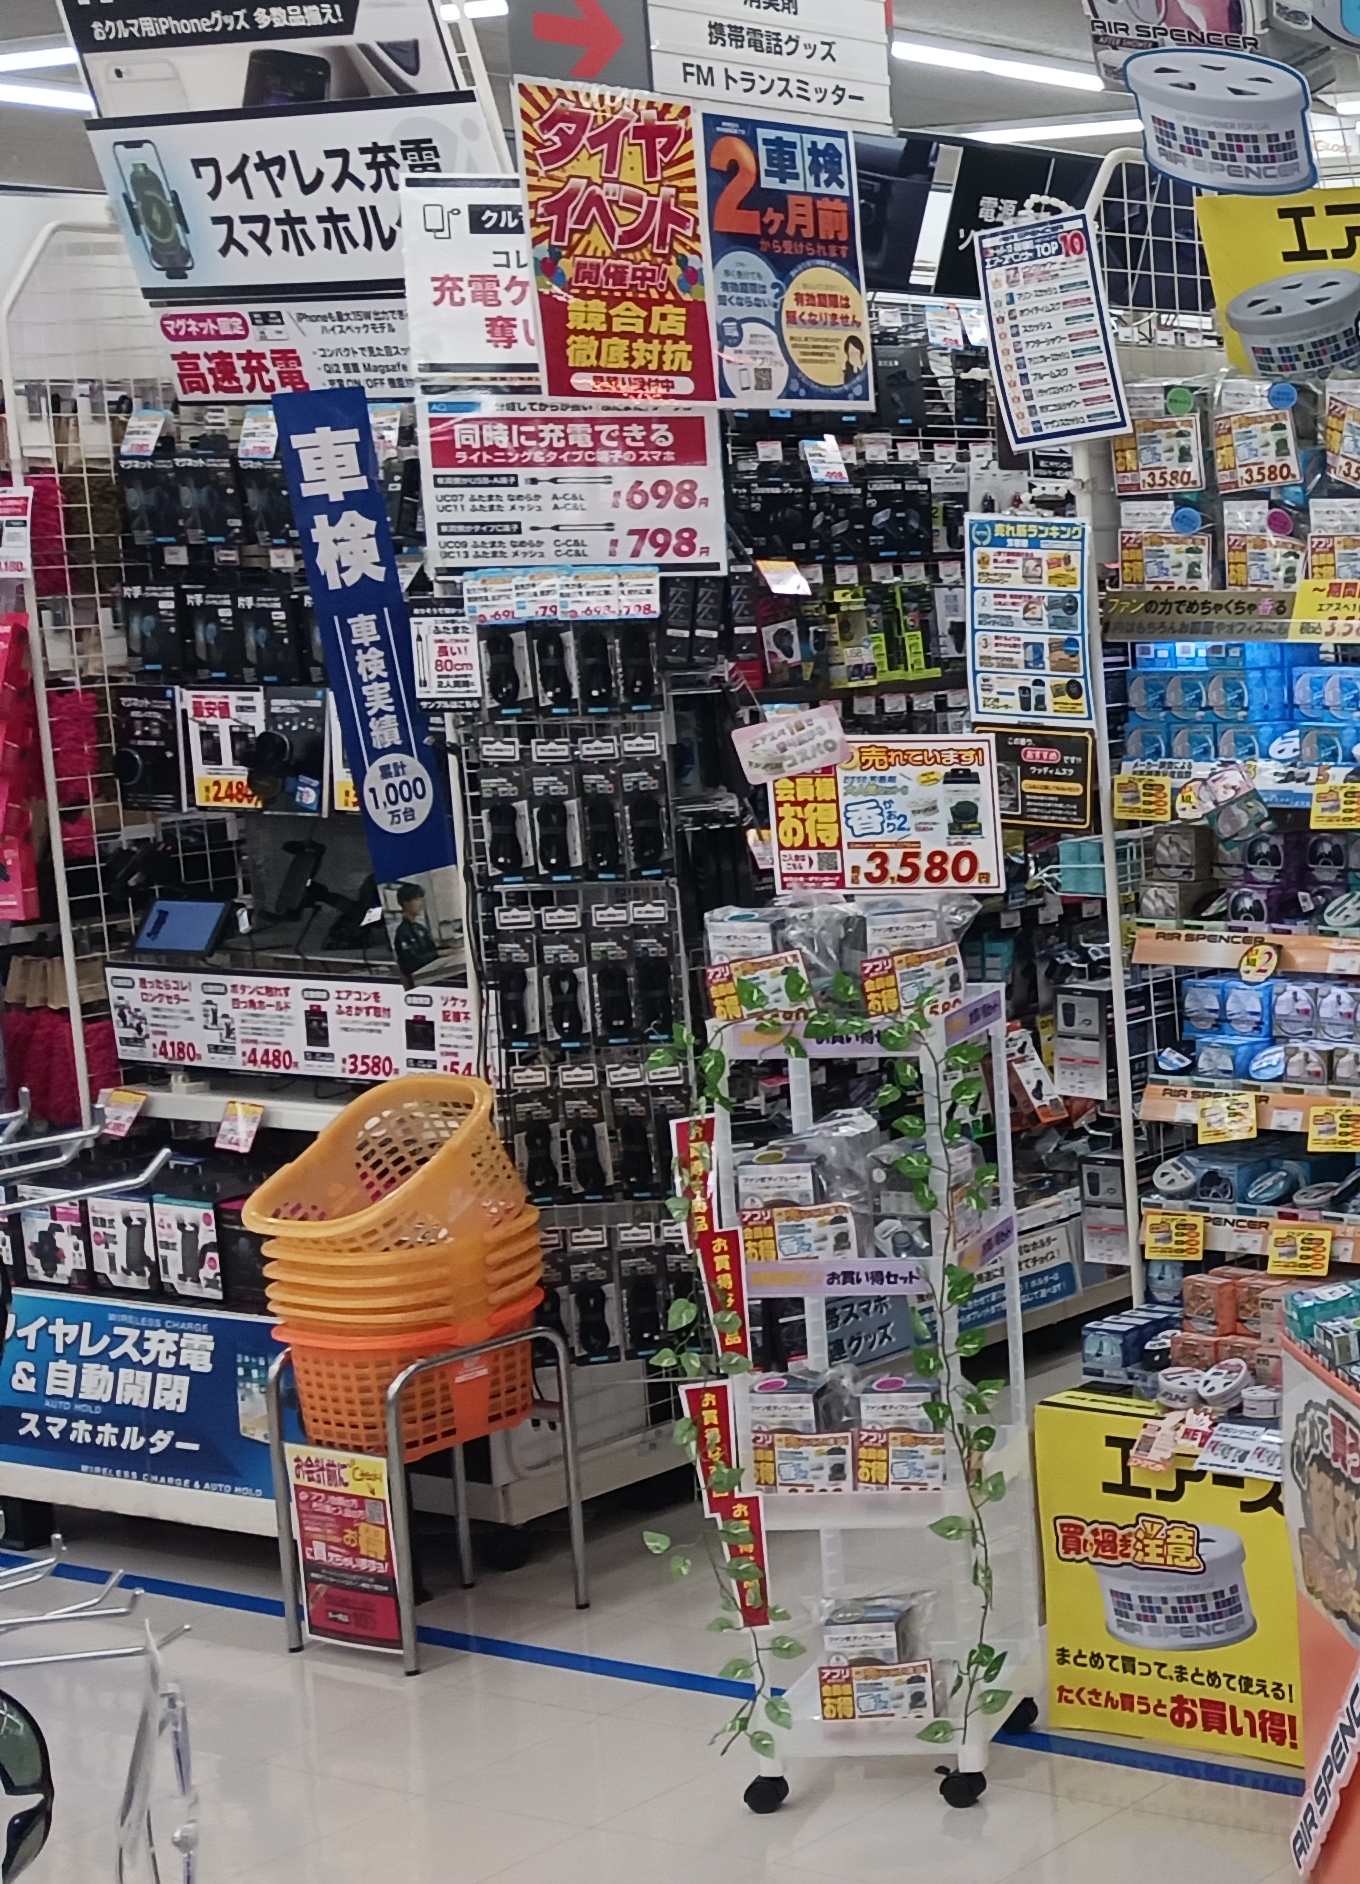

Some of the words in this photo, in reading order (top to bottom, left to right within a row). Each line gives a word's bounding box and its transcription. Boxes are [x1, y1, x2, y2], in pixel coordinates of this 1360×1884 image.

[707, 22, 837, 63] 携帯電話グッズ
[1091, 20, 1130, 37] AIR
[1134, 25, 1259, 50] SPENCER
[682, 64, 715, 88] FM
[725, 69, 865, 104] トランスミッター
[537, 98, 688, 181] タイヤ
[762, 136, 846, 189] 車検
[1157, 148, 1187, 167] AIR
[1192, 155, 1301, 180] SPENCER
[217, 205, 402, 258] スマホホル
[537, 178, 696, 254] イベント
[1035, 241, 1059, 257] TOP
[1060, 229, 1087, 259] 10
[573, 259, 667, 290] 開催中!
[566, 302, 687, 336] 競合店
[171, 349, 310, 395] 高速充電
[566, 338, 692, 371] 徹底対抗
[454, 424, 675, 450] 同時に充電できる
[290, 424, 388, 591] 車検
[1106, 597, 1288, 617] ファンの力でめちゃくちゃ香る
[347, 612, 405, 752] 車検実績
[434, 659, 474, 673] 80cm
[379, 762, 408, 780] 累計
[367, 777, 428, 810] 1,000
[386, 807, 418, 826] 万台
[778, 802, 840, 848] お得
[1155, 931, 1181, 944] AIR
[1184, 933, 1266, 947] SPENCER
[140, 992, 191, 1005] ロングセラー
[1161, 1088, 1189, 1100] AIR
[826, 1269, 921, 1287] お買い得セット
[11, 1367, 37, 1394] &
[45, 1360, 191, 1413] 自動開閉
[17, 1414, 201, 1454] スマホホルダー
[1055, 1515, 1204, 1572] 買い過ぎ注意
[1055, 1646, 1295, 1704] まとめて買って、まとめて使える!
[1055, 1683, 1300, 1750] たくさん買うとお買い得!
[1292, 1808, 1322, 1871] AIR
